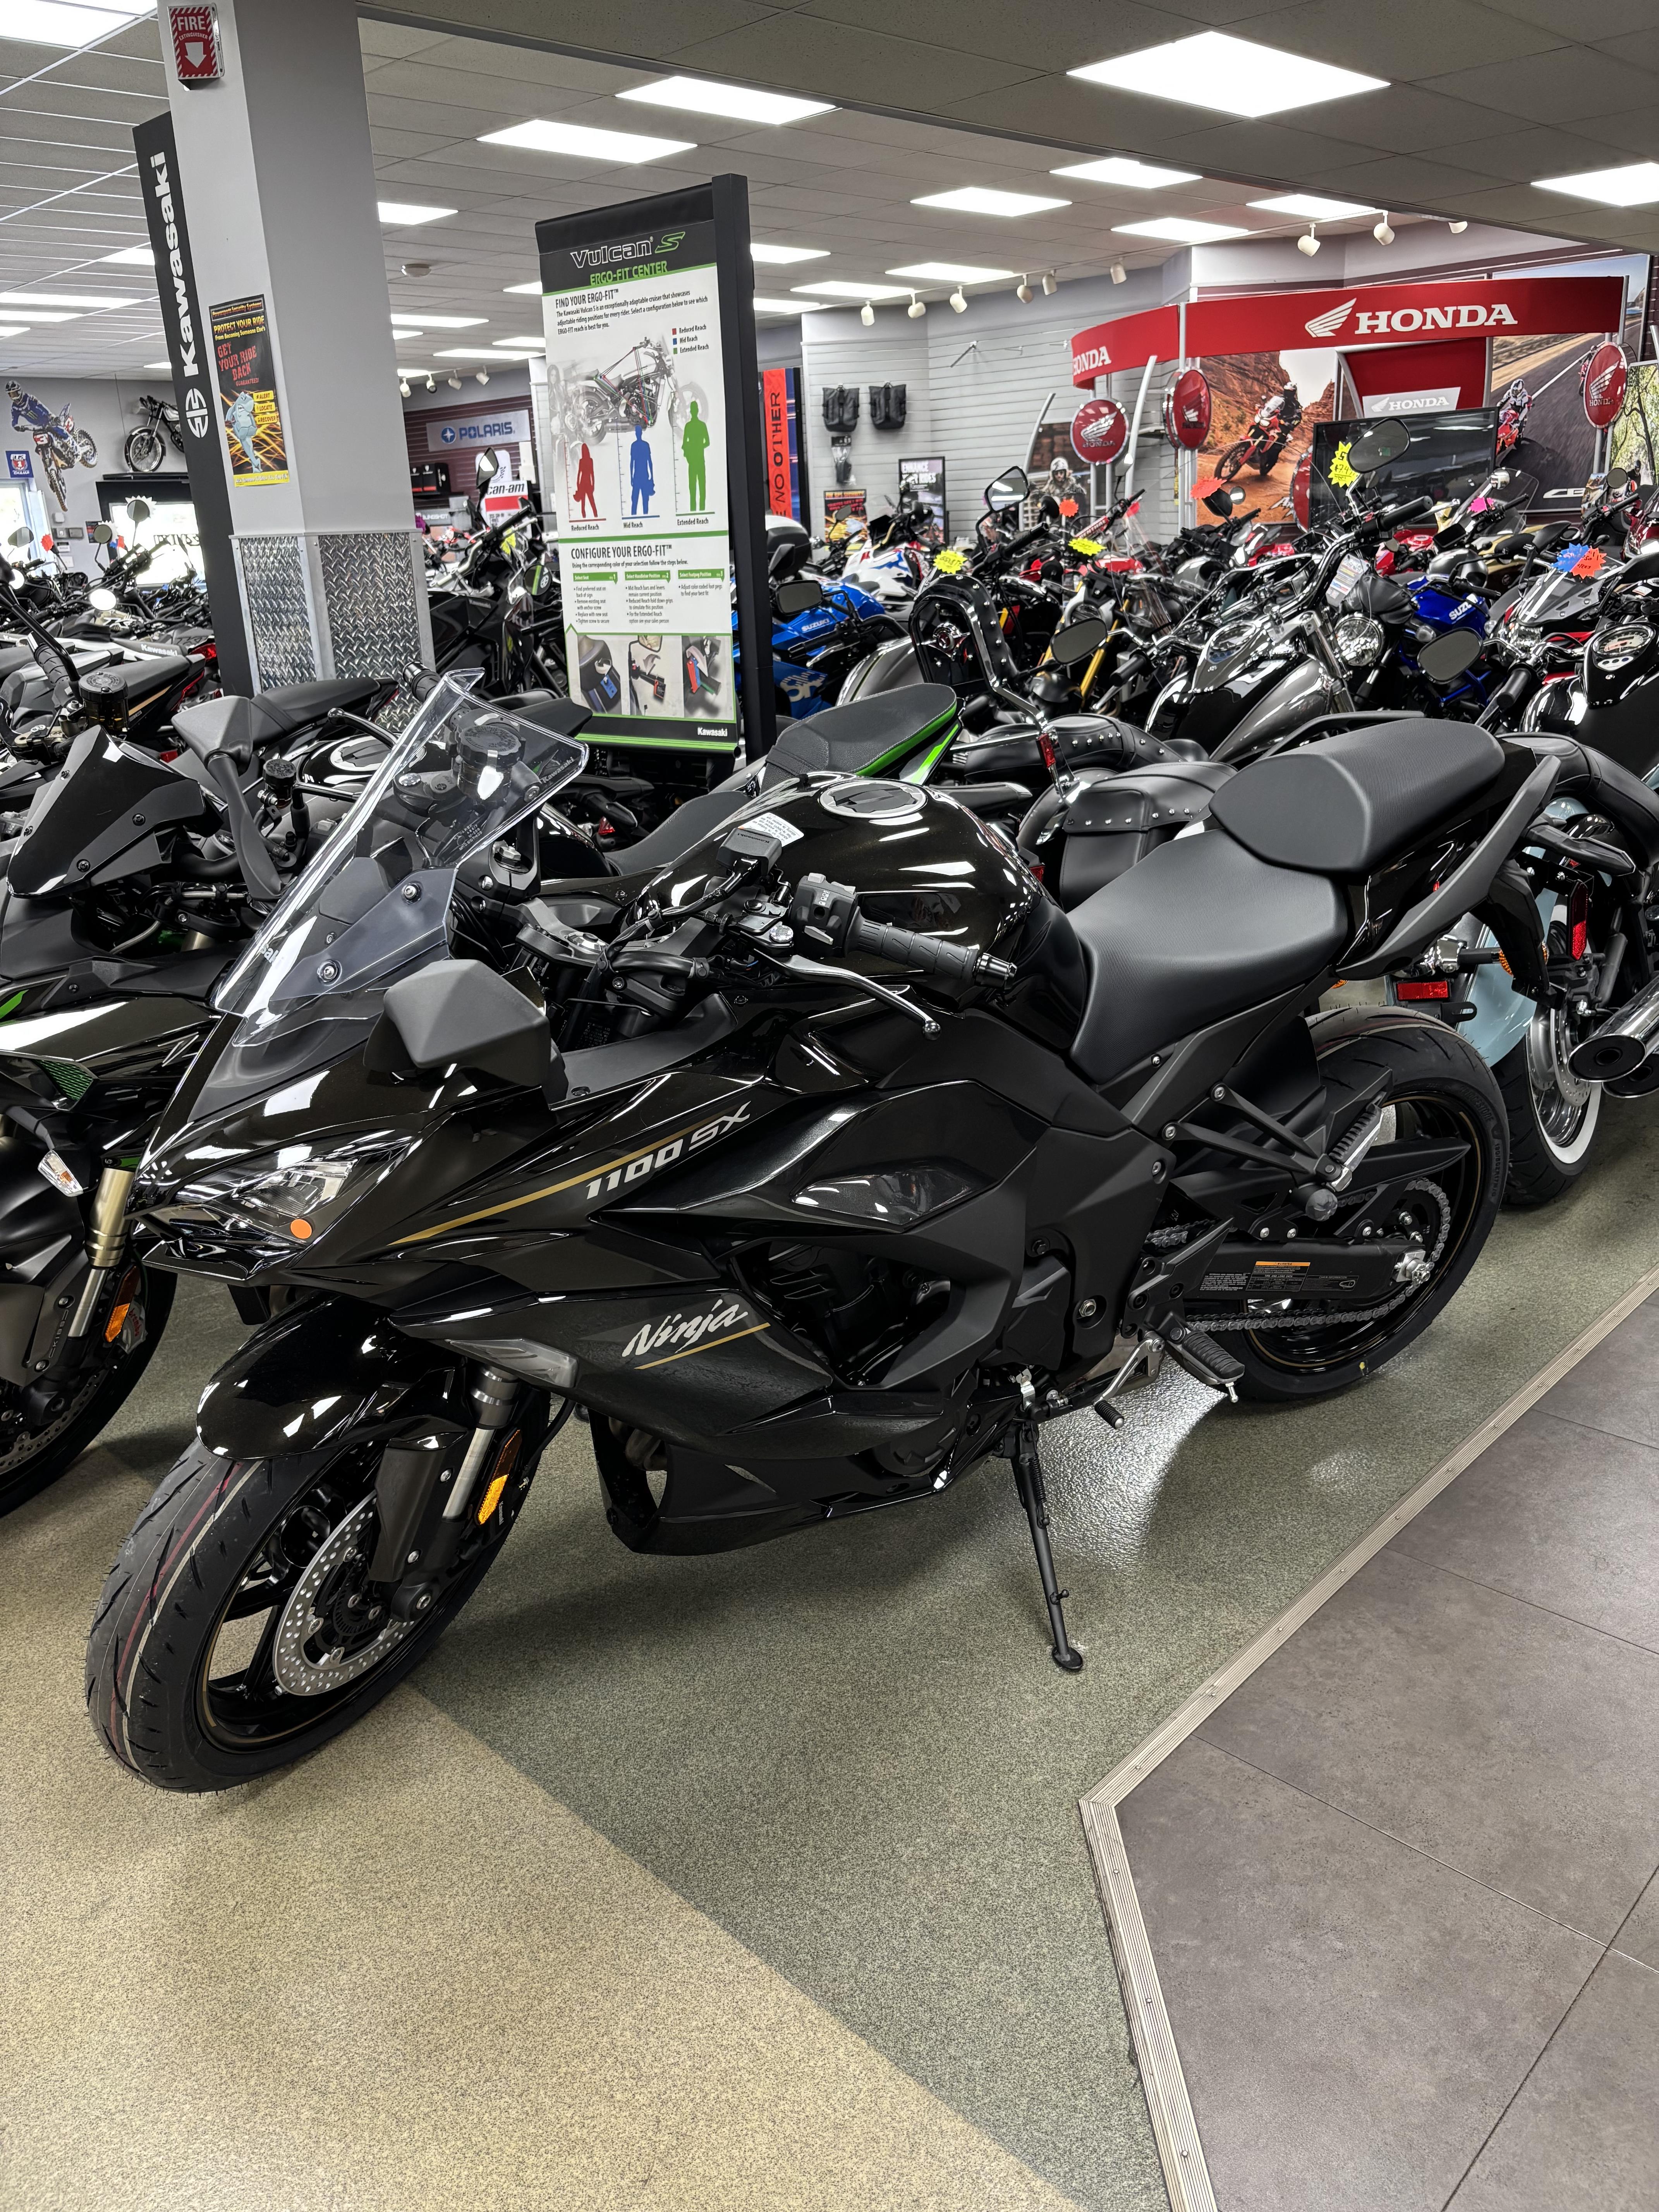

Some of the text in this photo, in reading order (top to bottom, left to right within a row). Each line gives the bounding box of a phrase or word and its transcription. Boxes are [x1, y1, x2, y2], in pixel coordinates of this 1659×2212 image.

[177, 16, 206, 31] FIRE
[179, 32, 208, 41] EXTINGUISHER
[570, 232, 685, 268] Vulcan S
[150, 151, 199, 377] Kawasaki
[590, 261, 667, 286] ERGO-FIT CENTER
[556, 297, 569, 309] FIND
[570, 294, 586, 306] YOUR
[604, 300, 629, 310] exceptionally
[629, 297, 648, 306] adaptable
[646, 302, 672, 312] configuration
[214, 315, 264, 334] PROTECT YOUR RIDE
[1355, 304, 1518, 334] HONDA
[224, 331, 240, 339] Becoming
[217, 342, 232, 358] GET
[218, 345, 257, 372] YOUR RIDE
[1073, 346, 1111, 376] HONDA
[232, 362, 251, 381] BACK
[1389, 396, 1449, 411] HONDA
[459, 421, 513, 440] POLARIS
[771, 392, 783, 467] OTHER
[486, 484, 524, 495] can-am
[775, 474, 785, 503] NO
[571, 547, 611, 559] CONFIGURE
[612, 546, 631, 558] YOUR
[802, 618, 830, 632] SUZUKI
[141, 644, 178, 656] Kawasaki
[697, 727, 727, 737] Kawasaki
[542, 756, 575, 783] Kawasaki
[737, 833, 770, 843] Kawasaki
[622, 1299, 749, 1357] Ninja
